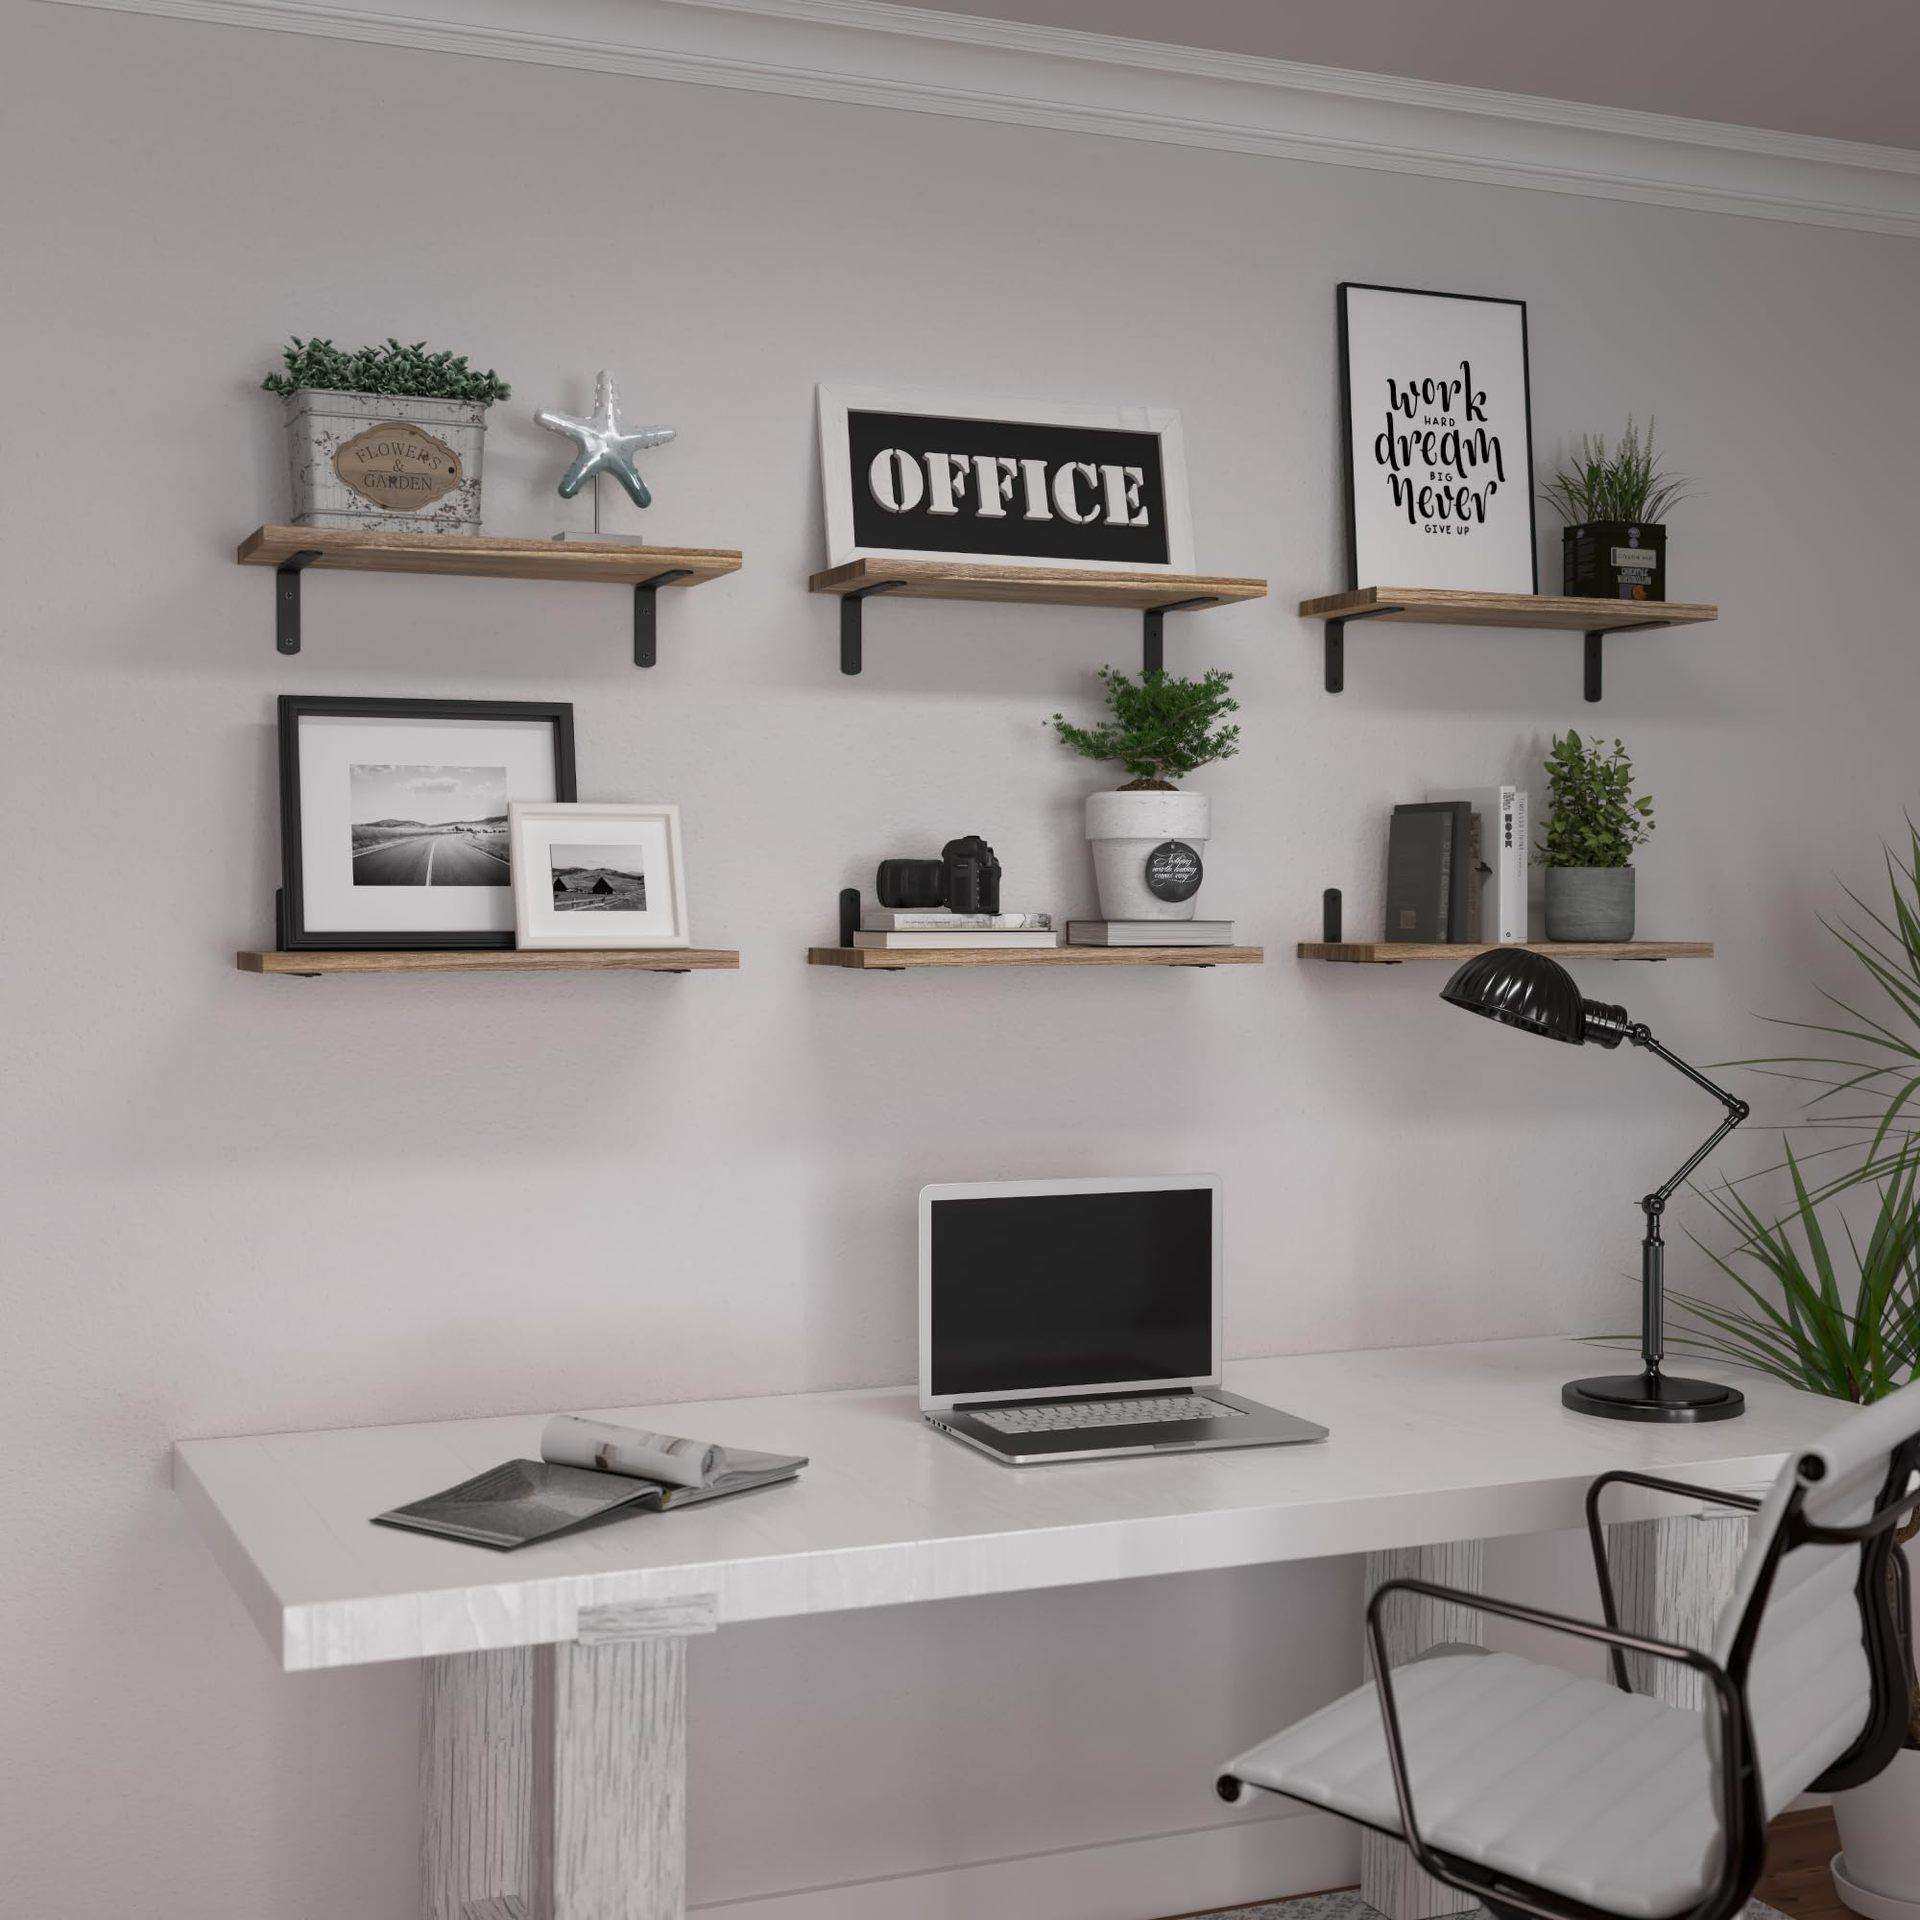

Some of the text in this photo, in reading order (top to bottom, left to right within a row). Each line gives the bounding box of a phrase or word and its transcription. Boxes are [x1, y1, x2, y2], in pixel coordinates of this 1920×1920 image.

[1386, 360, 1488, 422] work
[1424, 415, 1456, 427] HARD
[355, 442, 442, 470] FLOWERS
[1374, 411, 1506, 483] dream
[364, 473, 432, 491] GARDEN
[868, 448, 1149, 527] OFFICE
[1429, 471, 1453, 482] BIG
[1386, 473, 1498, 525] never
[1424, 524, 1470, 535] GIVE UP
